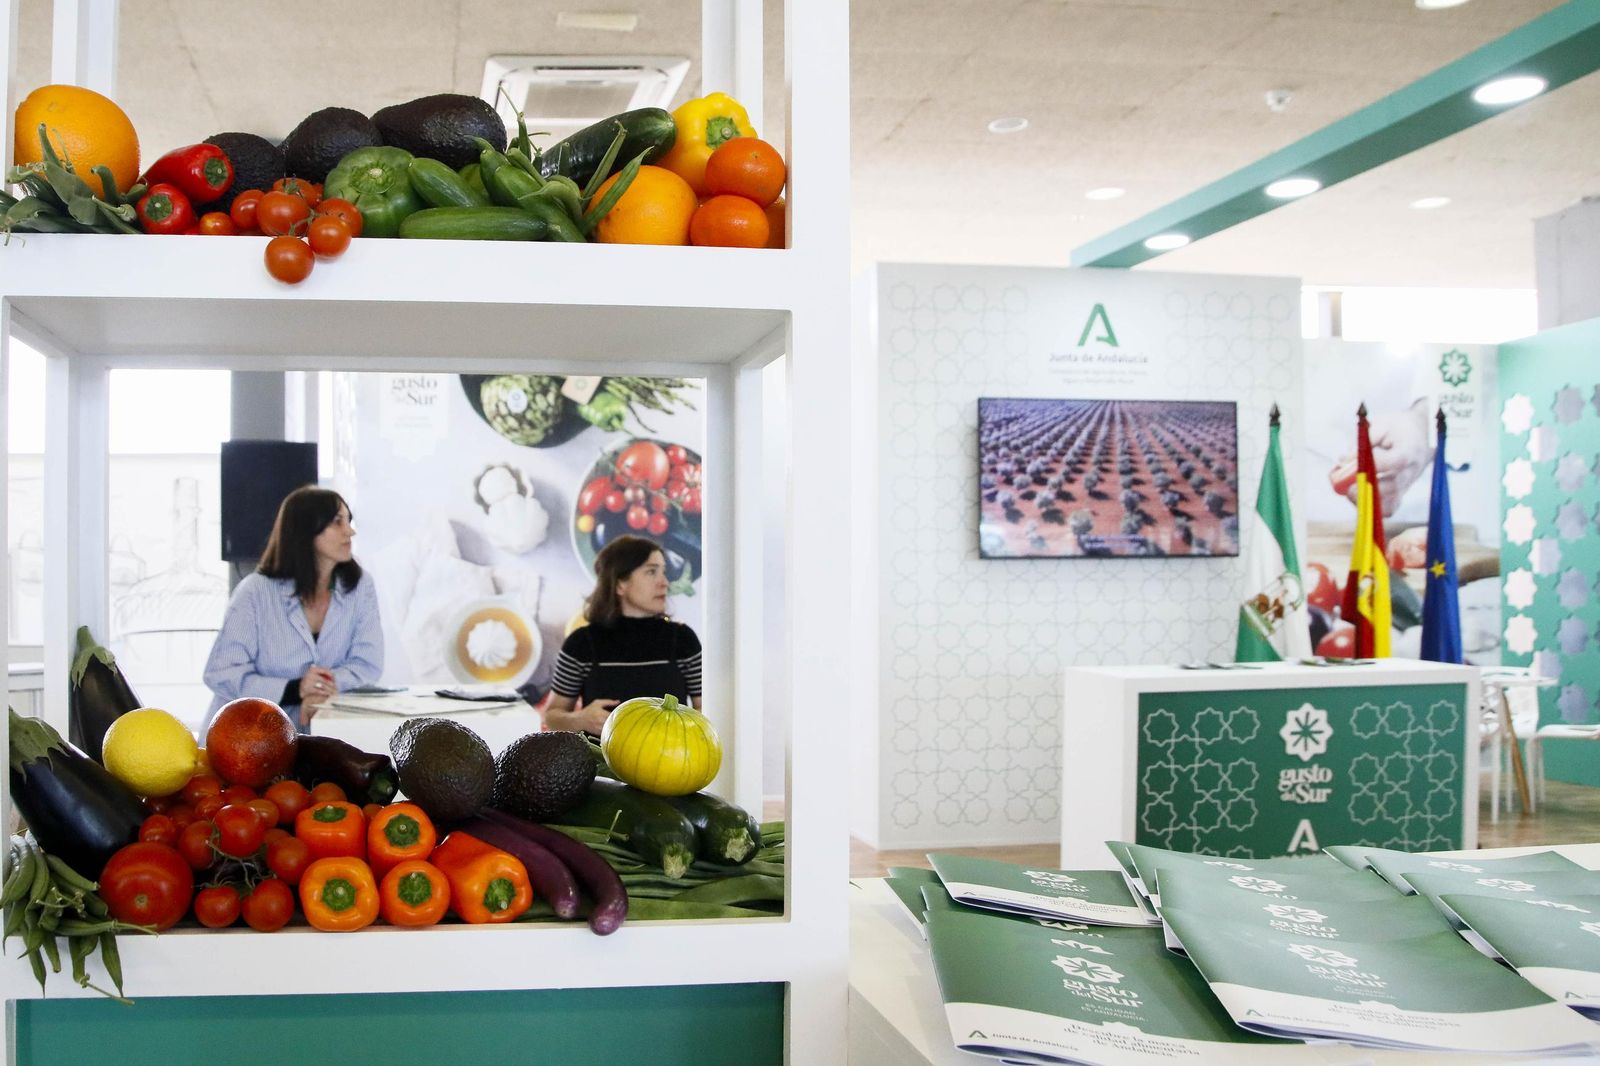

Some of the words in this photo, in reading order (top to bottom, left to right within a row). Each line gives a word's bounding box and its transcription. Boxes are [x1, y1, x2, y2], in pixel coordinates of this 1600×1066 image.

[1278, 764, 1333, 792] gusto
[1295, 783, 1333, 804] Sur
[1062, 978, 1139, 999] gusto
[1090, 989, 1144, 1008] Sur
